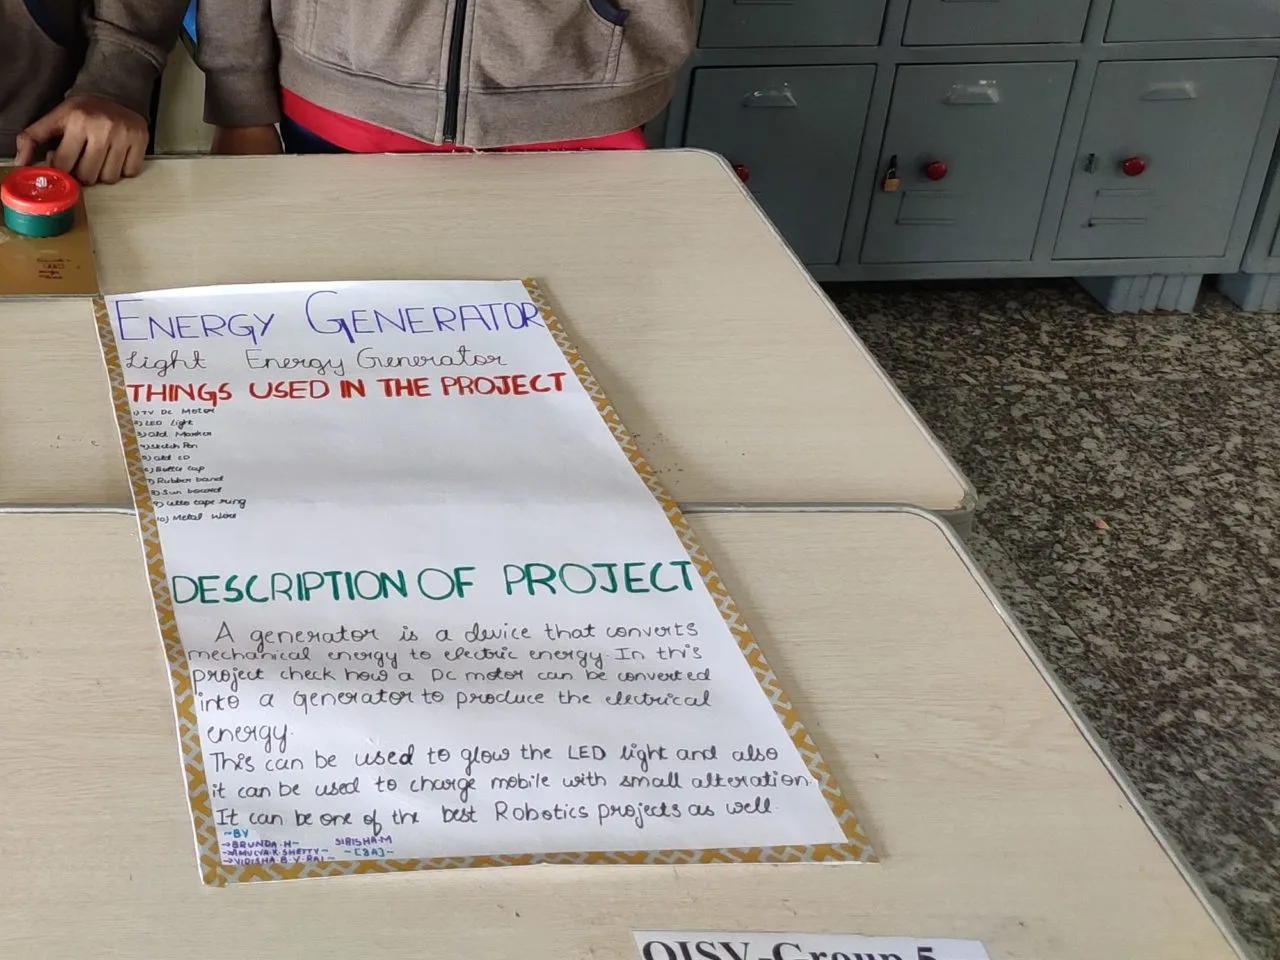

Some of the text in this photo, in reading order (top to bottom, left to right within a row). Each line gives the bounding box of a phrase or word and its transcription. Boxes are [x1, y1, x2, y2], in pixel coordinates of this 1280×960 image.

[114, 290, 545, 345] ENERGY GENERATOR
[126, 346, 508, 377] Light Energy Generator
[127, 372, 568, 407] THINGS USED IN THE PROJECT
[173, 513, 203, 521] Metal
[172, 560, 694, 604] DESCRIPTION OF PROJECT
[214, 621, 699, 653] A generator is a device that converts
[188, 647, 311, 662] mechanical
[328, 649, 398, 669] energy
[411, 647, 431, 660] to
[444, 646, 519, 661] electric
[614, 647, 645, 661] In
[656, 643, 703, 660] this
[192, 666, 712, 694] project check how a DC motor can be converted
[197, 692, 241, 712] into
[259, 693, 274, 708] a
[422, 690, 444, 704] to
[457, 689, 544, 709] produce
[558, 689, 592, 704] the
[605, 689, 712, 707] electrical
[209, 743, 778, 776] This can be used to glow the LED light and also
[212, 783, 225, 799] it
[238, 786, 271, 798] can
[279, 782, 300, 797] be
[315, 780, 360, 797] used
[377, 779, 397, 792] to
[410, 776, 476, 803] charge
[491, 773, 549, 790] mobile
[563, 771, 606, 788] with
[619, 772, 683, 789] small
[216, 808, 239, 827] It
[249, 812, 283, 826] can
[295, 809, 312, 826] be
[320, 813, 352, 826] one
[364, 809, 383, 836] of
[392, 808, 420, 825] the
[442, 805, 478, 824] best
[495, 800, 589, 822] Robotics
[598, 800, 682, 829] projects
[688, 803, 715, 817] as
